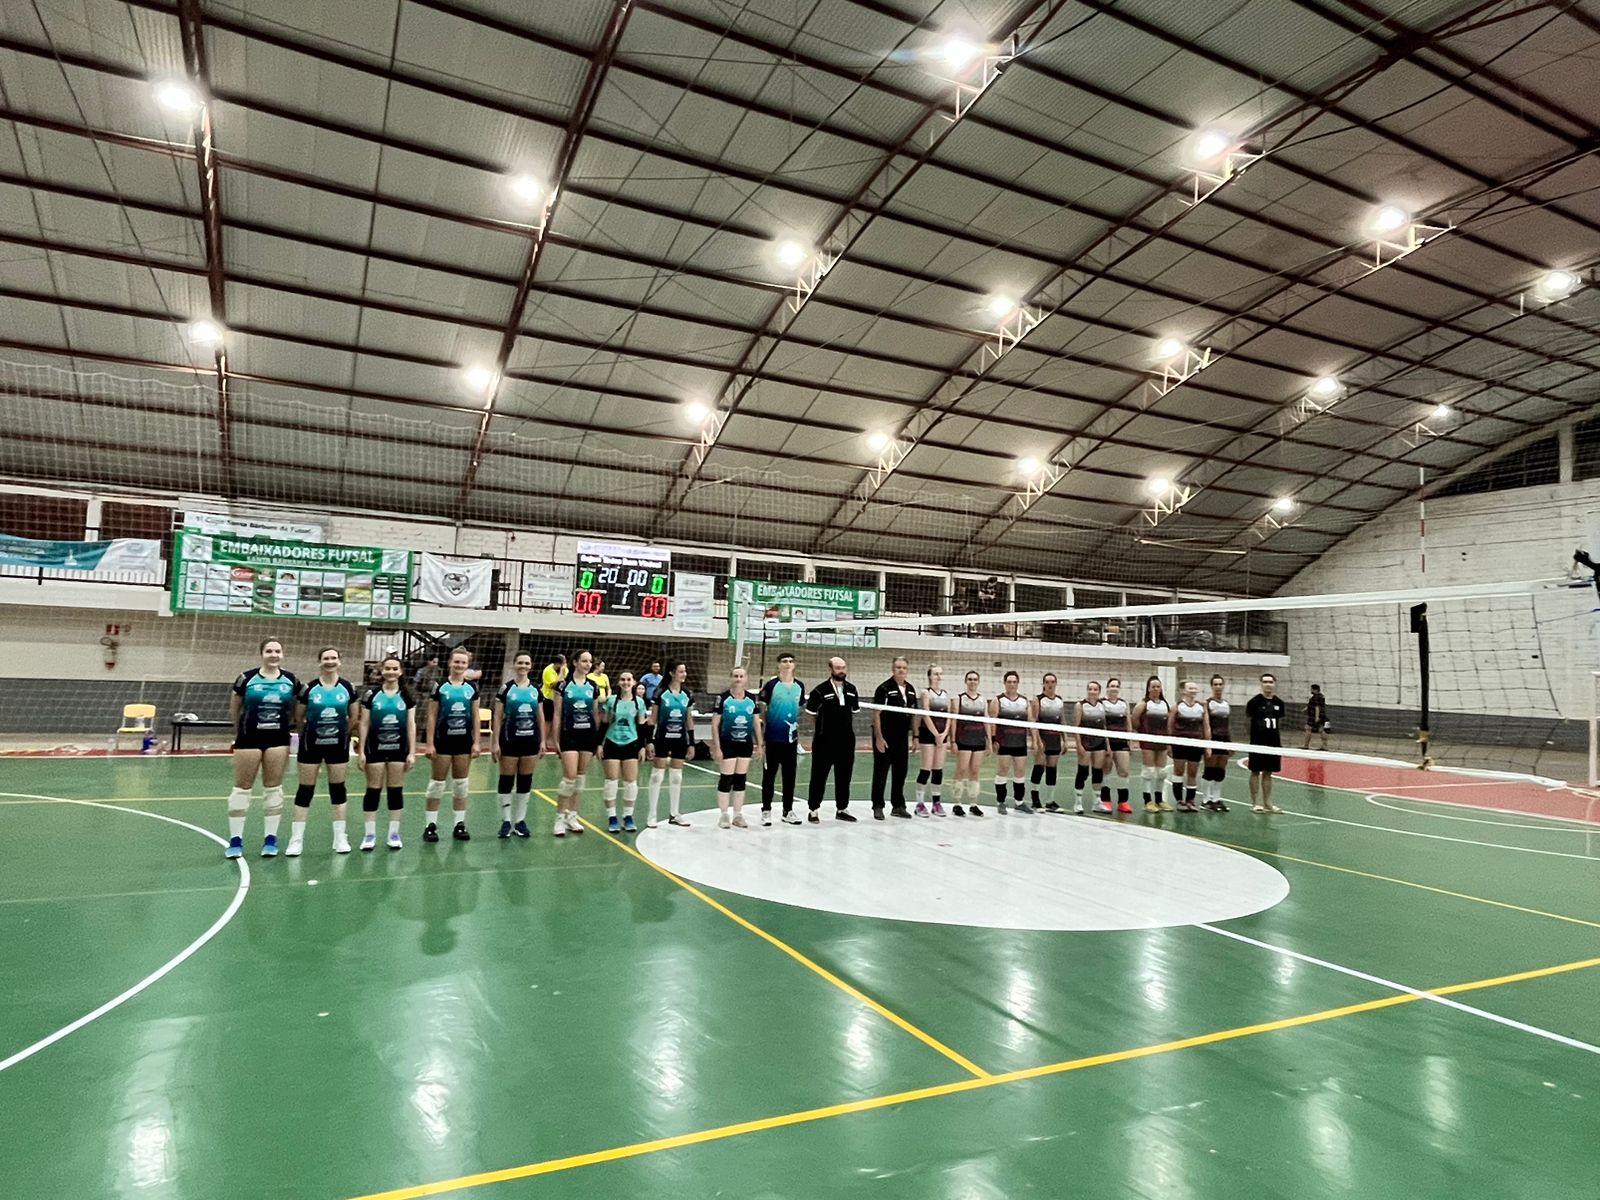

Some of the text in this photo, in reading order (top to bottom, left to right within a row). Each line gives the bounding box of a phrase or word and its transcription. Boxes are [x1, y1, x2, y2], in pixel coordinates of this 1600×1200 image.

[219, 540, 376, 564] EMBAIXADORES FUTSAL
[580, 571, 593, 589] 0
[598, 568, 648, 586] 20 00
[651, 576, 664, 594] 0
[575, 591, 602, 614] 00
[824, 589, 854, 601] FUTSAL
[641, 596, 667, 618] 00
[1264, 717, 1277, 729] 11
